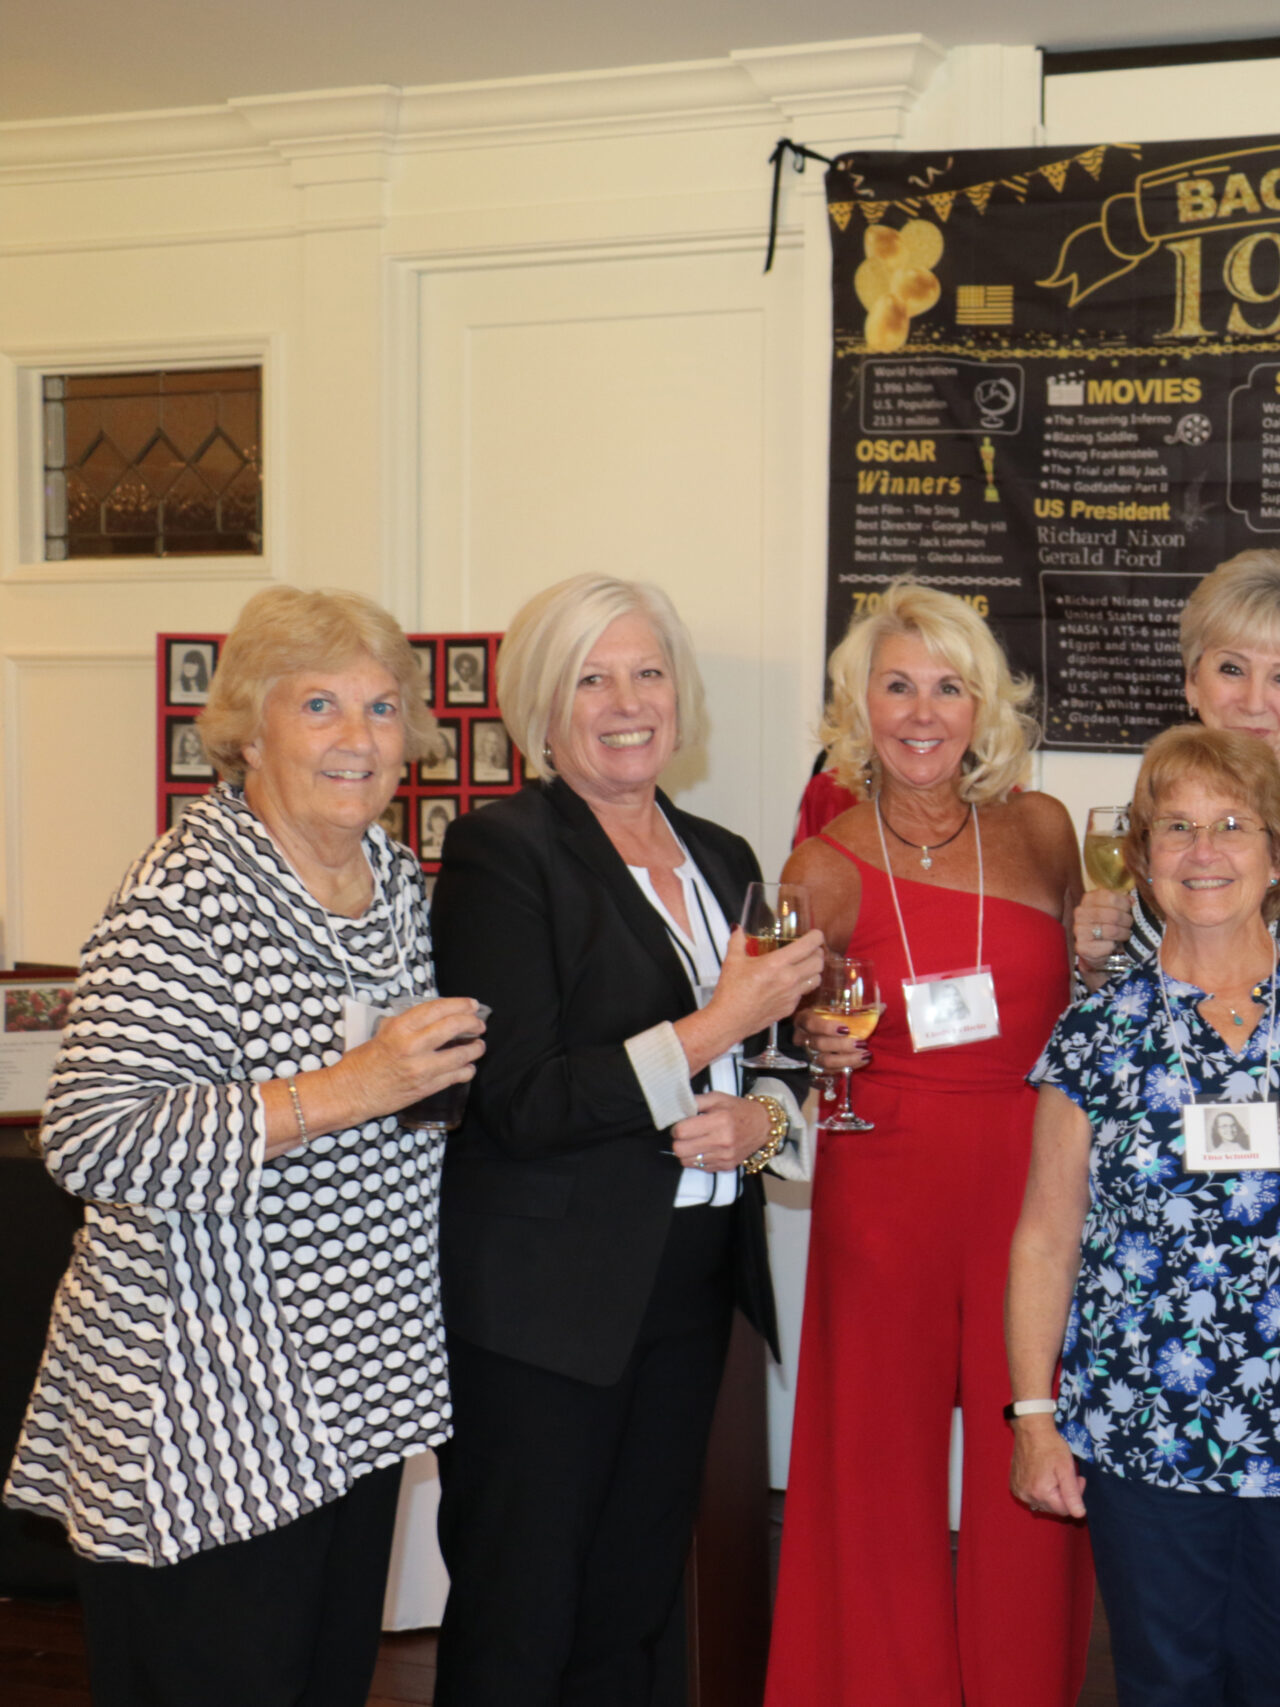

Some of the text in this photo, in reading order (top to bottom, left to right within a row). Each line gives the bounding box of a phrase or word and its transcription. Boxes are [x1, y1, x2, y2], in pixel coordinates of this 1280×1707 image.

[873, 366, 957, 377] World Population
[1087, 377, 1202, 405] MOVIES
[873, 399, 948, 411] U.S. Population
[905, 415, 940, 426] million
[1053, 414, 1172, 427] The Towering Inferno
[1053, 432, 1138, 445] Blazing Saddles
[855, 439, 937, 462] OSCAR
[1051, 449, 1158, 462] Young Frankenstein
[1050, 465, 1168, 479] The Trial of Billy Jack
[857, 469, 962, 496] Winners
[1049, 481, 1070, 491] The
[1074, 481, 1132, 493] Godfather
[1136, 483, 1157, 493] Part
[856, 504, 960, 518] Best Film The Sting
[1034, 498, 1171, 521] US President
[855, 519, 1007, 534] Best Director George Roy Hill
[855, 535, 986, 548] Best Actor Jack Lemmon
[1037, 526, 1186, 547] Richard Nixon
[854, 551, 1004, 564] Best Actress Glenda Jackson
[1039, 547, 1162, 567] Gerald Ford
[1065, 595, 1109, 607] Richard
[1112, 596, 1149, 607] Nixon
[1153, 596, 1190, 608] beca
[1065, 610, 1103, 622] United
[1107, 611, 1144, 622] States
[1148, 612, 1162, 622] to
[1067, 625, 1109, 636] NASA's
[1113, 626, 1149, 637] ATS-6
[1068, 639, 1101, 652] Egypt
[1105, 639, 1126, 650] and
[1131, 640, 1150, 651] the
[1067, 654, 1130, 667] diplomatic
[1069, 668, 1110, 680] People
[1113, 670, 1181, 683] magazine's
[1100, 684, 1125, 695] with
[1129, 685, 1151, 695] Mia
[1106, 698, 1141, 709] White
